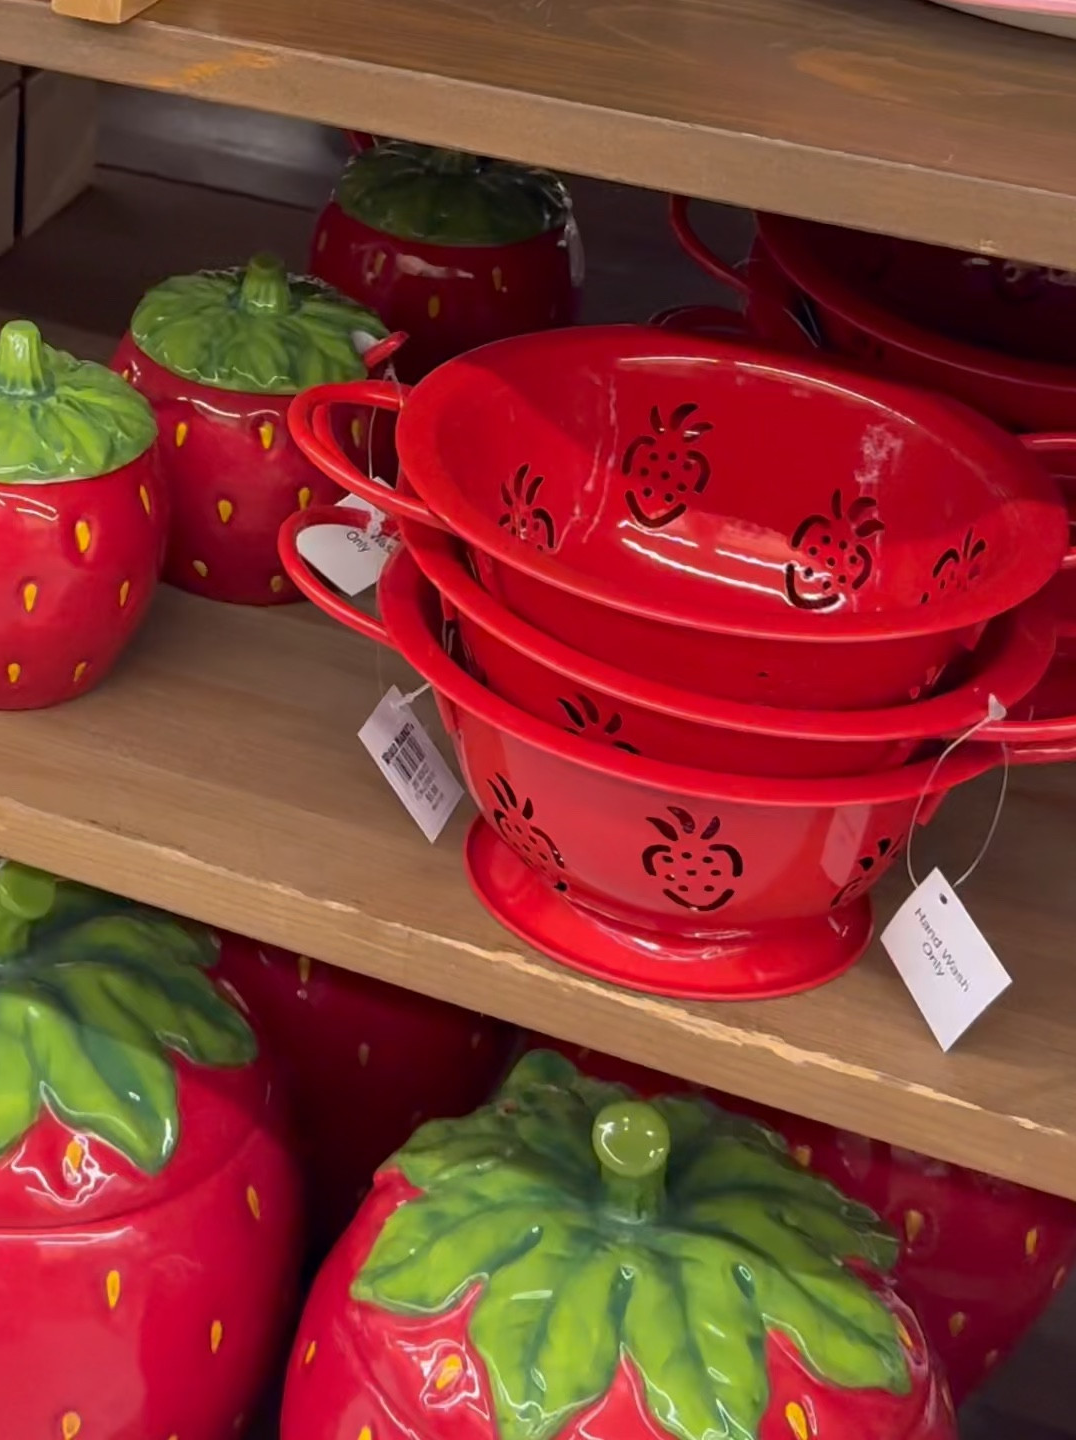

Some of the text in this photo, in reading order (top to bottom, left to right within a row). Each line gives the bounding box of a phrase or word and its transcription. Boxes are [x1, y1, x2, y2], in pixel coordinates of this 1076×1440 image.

[346, 531, 371, 553] Only
[914, 907, 969, 992] Hand Wash
[922, 941, 945, 977] Only
